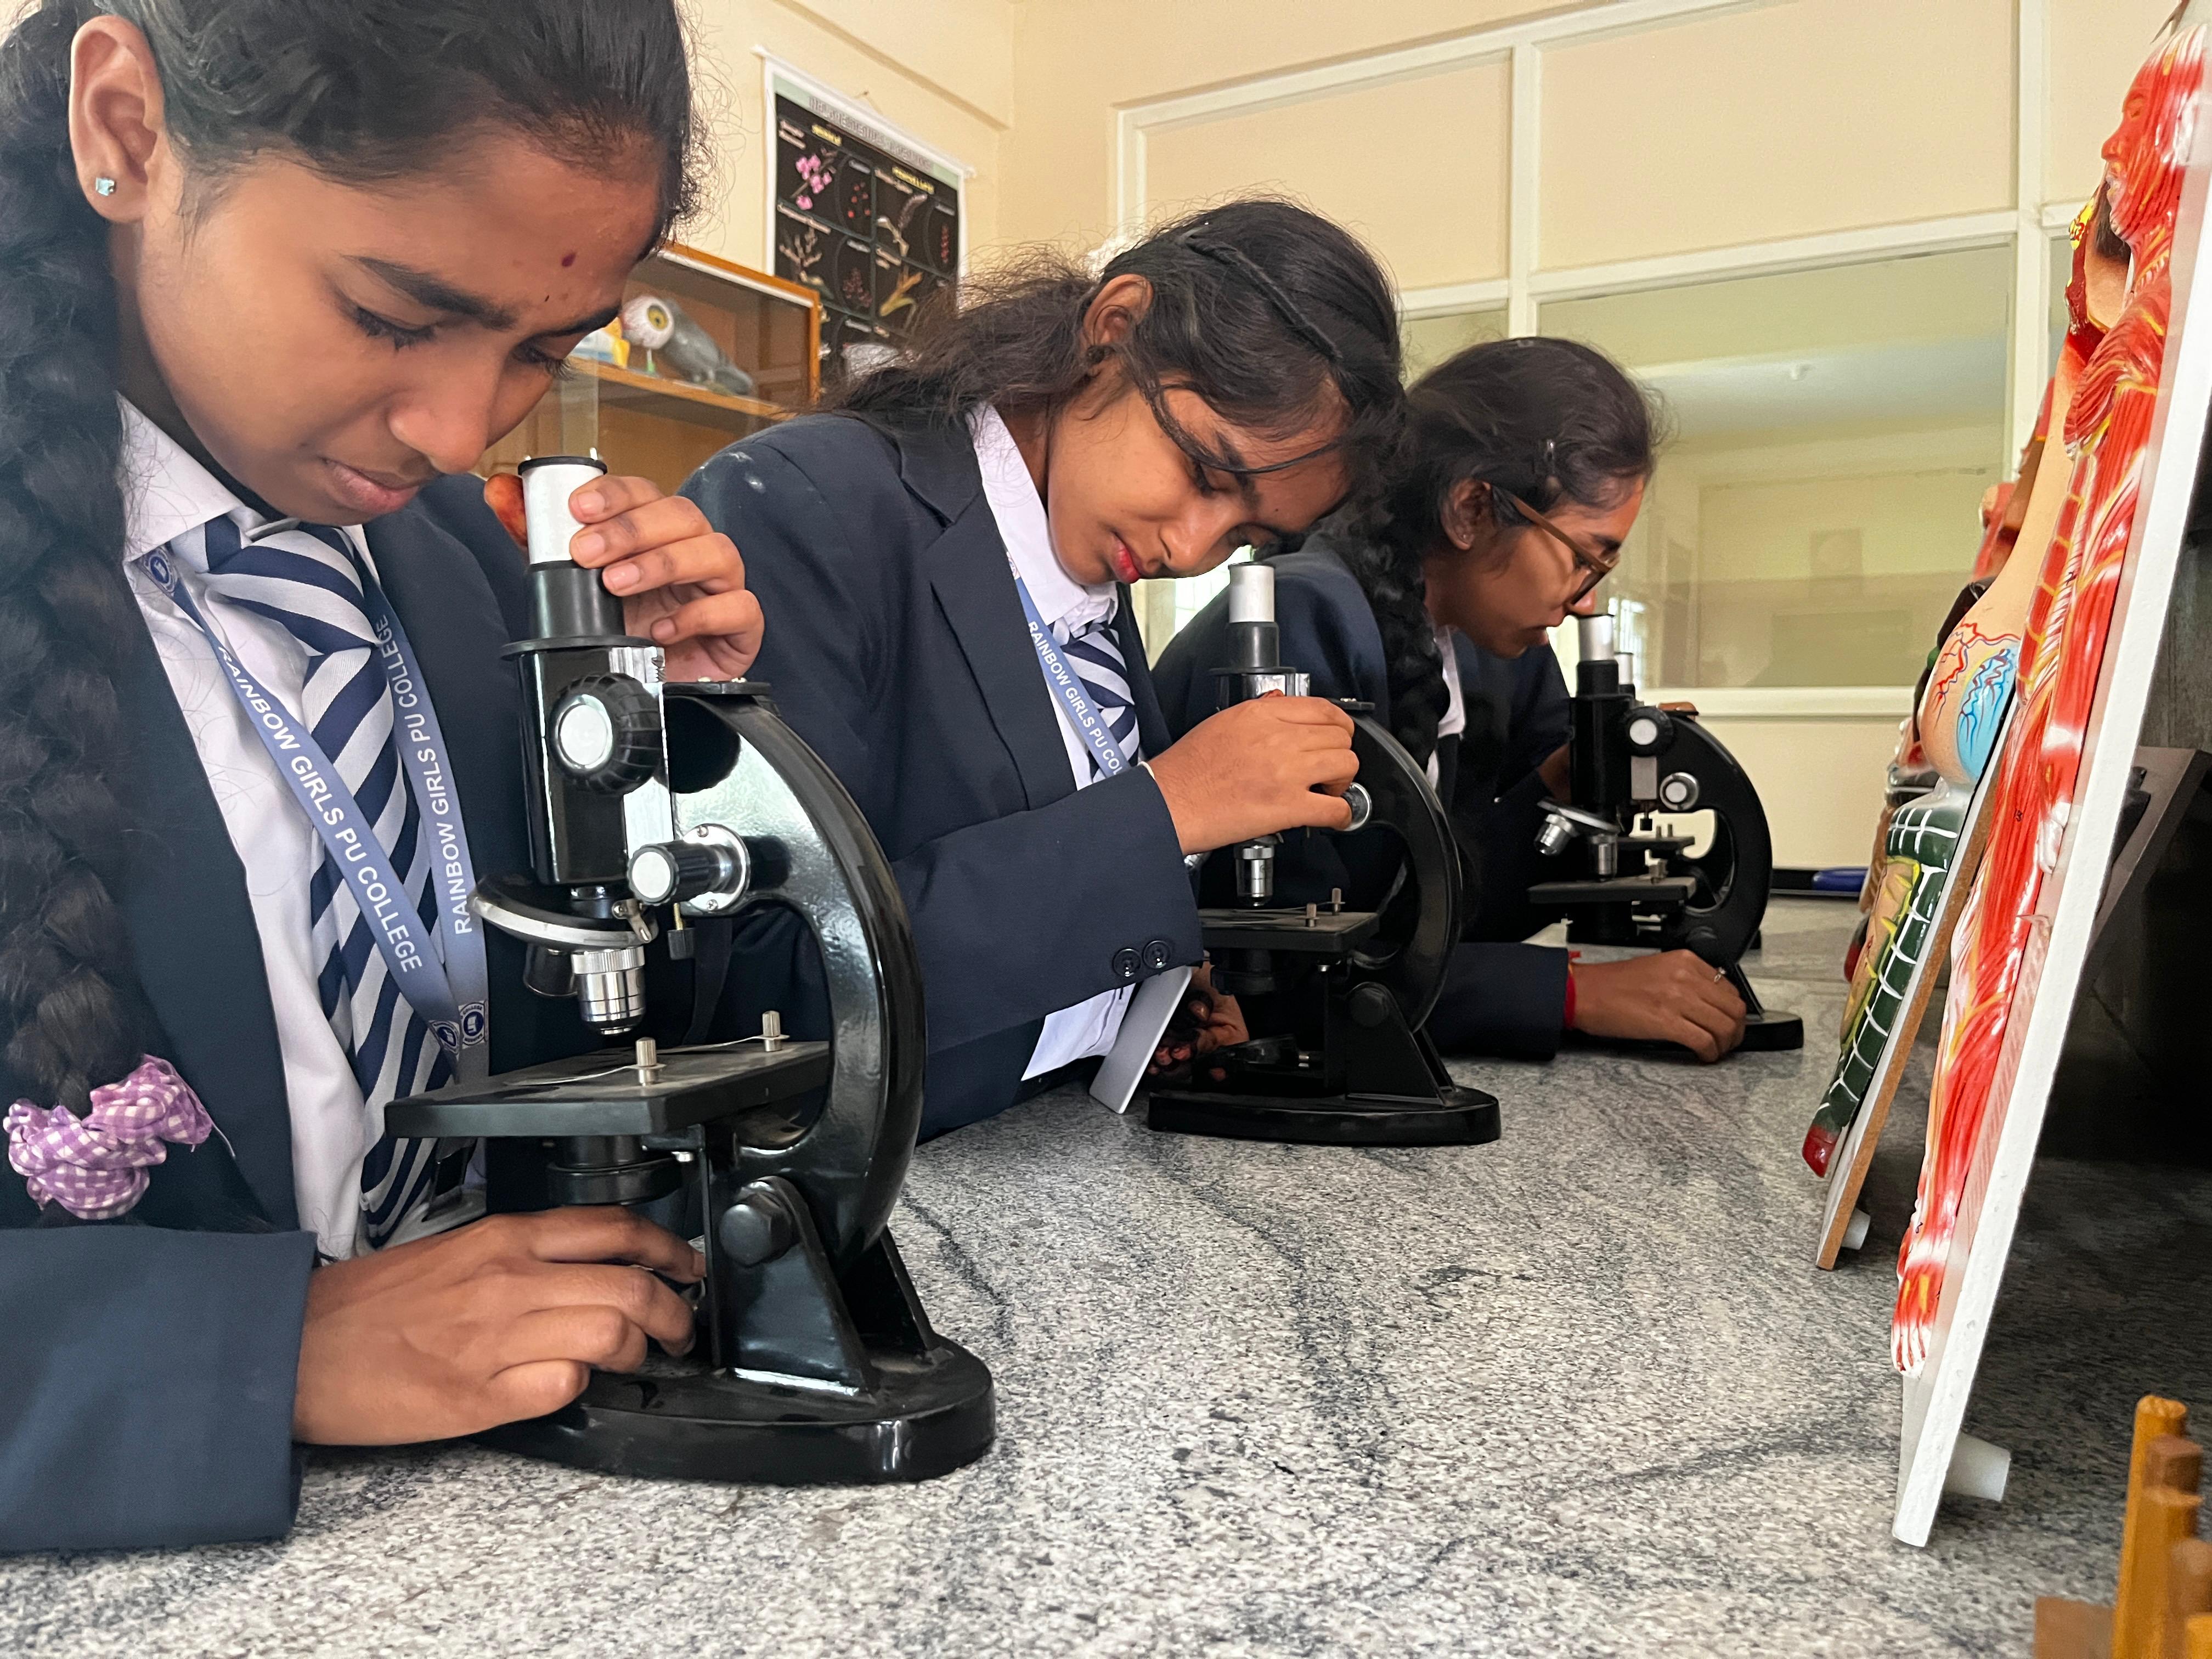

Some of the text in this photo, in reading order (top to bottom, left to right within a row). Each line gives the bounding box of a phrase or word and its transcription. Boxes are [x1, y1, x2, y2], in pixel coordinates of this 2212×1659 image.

[218, 646, 422, 972] RAINBOW GIRLS PU COLLEGE
[376, 614, 473, 934] RAINBOW GIRLS PU COLLEGE
[1028, 621, 1071, 686] RAINBOW
[1066, 687, 1094, 728] GIRLS
[1090, 728, 1108, 748] PU
